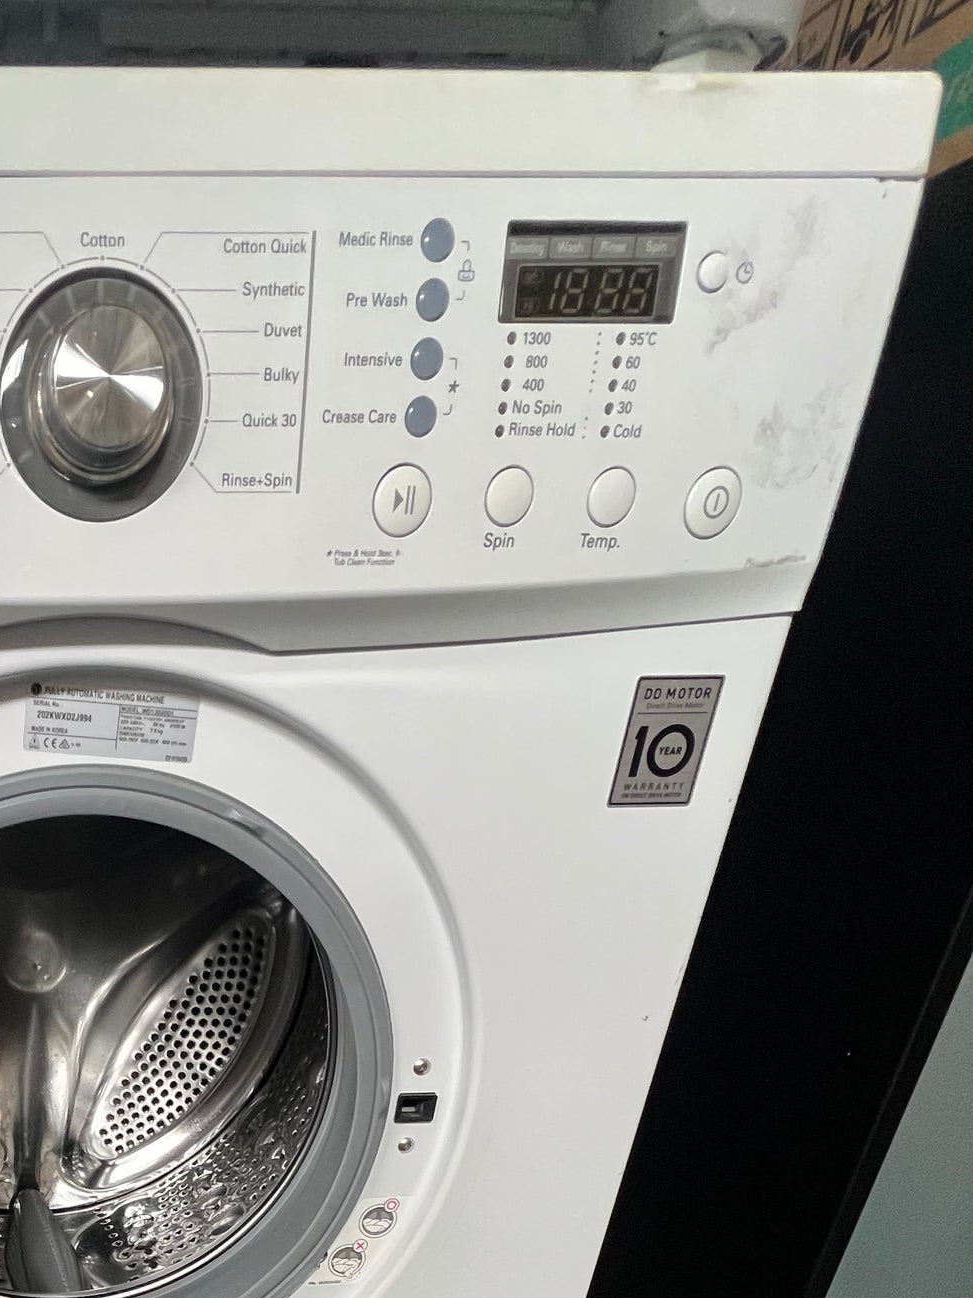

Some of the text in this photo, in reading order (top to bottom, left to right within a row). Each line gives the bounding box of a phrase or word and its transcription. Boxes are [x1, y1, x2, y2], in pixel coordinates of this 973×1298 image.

[80, 232, 125, 248] Cotton
[339, 231, 413, 246] Medic Rinse
[224, 239, 307, 254] Cotton Quick
[242, 282, 305, 299] Synthetic
[346, 292, 408, 307] Pre Wash
[264, 322, 302, 337] Duvet
[523, 331, 551, 345] 1300
[344, 352, 403, 366] Intensive
[526, 355, 548, 368] 800
[625, 355, 641, 369] 60
[263, 367, 300, 384] Bulky
[522, 378, 544, 391] 400
[621, 378, 637, 392] 40
[512, 400, 562, 417] No Spin
[617, 401, 633, 414] 30
[242, 413, 297, 428] Quick 30
[322, 409, 397, 423] Crease Care
[508, 422, 576, 437] Rinse Hold
[613, 424, 642, 438] Cold
[222, 473, 293, 488] Rinse+Spin
[483, 532, 515, 551] Spin
[580, 533, 621, 551] Temp.
[44, 686, 165, 705] FULLY AUTOMATIC WASHING MACHINE
[644, 687, 712, 699] DD MOTOR
[628, 723, 695, 778] 10
[659, 746, 682, 755] YEAR
[623, 782, 684, 791] WARRANTY
